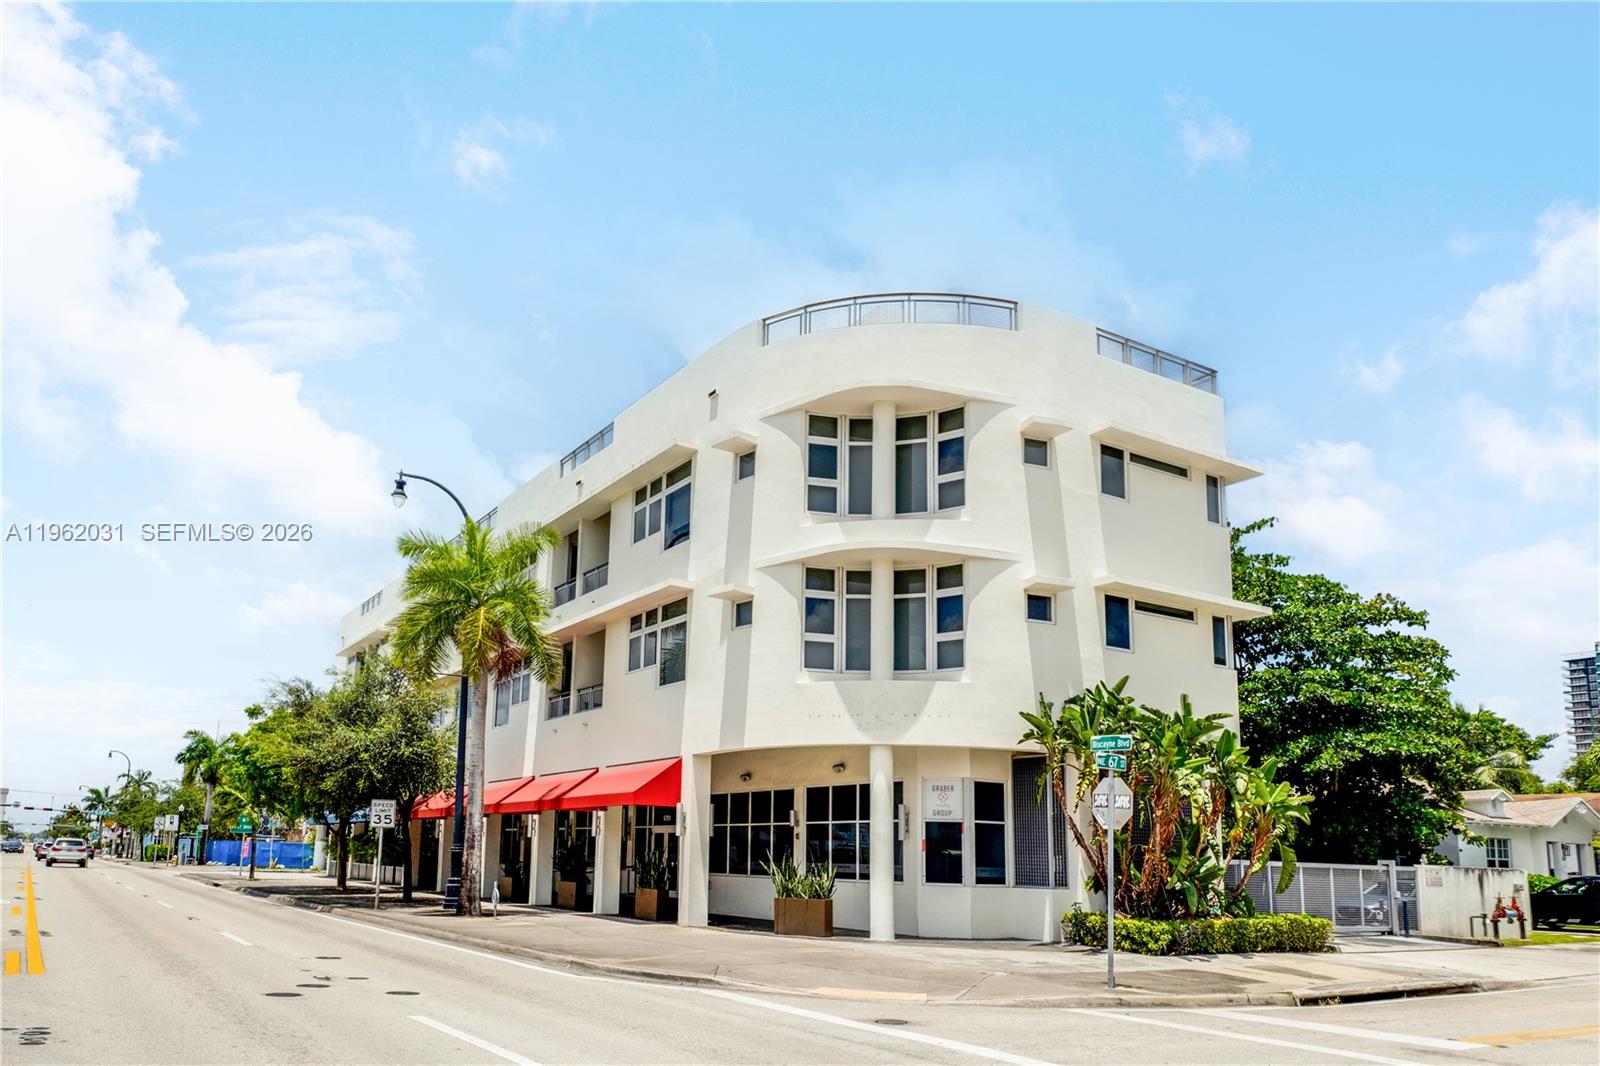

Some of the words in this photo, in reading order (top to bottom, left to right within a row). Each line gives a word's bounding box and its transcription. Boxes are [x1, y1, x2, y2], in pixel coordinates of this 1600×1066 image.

[1092, 740, 1116, 749] Biscayne
[1117, 739, 1130, 748] Blvd
[1097, 757, 1106, 766] NE
[1108, 756, 1119, 768] 67
[931, 784, 955, 792] GRABER
[932, 809, 953, 817] GROUP
[373, 814, 393, 825] 35
